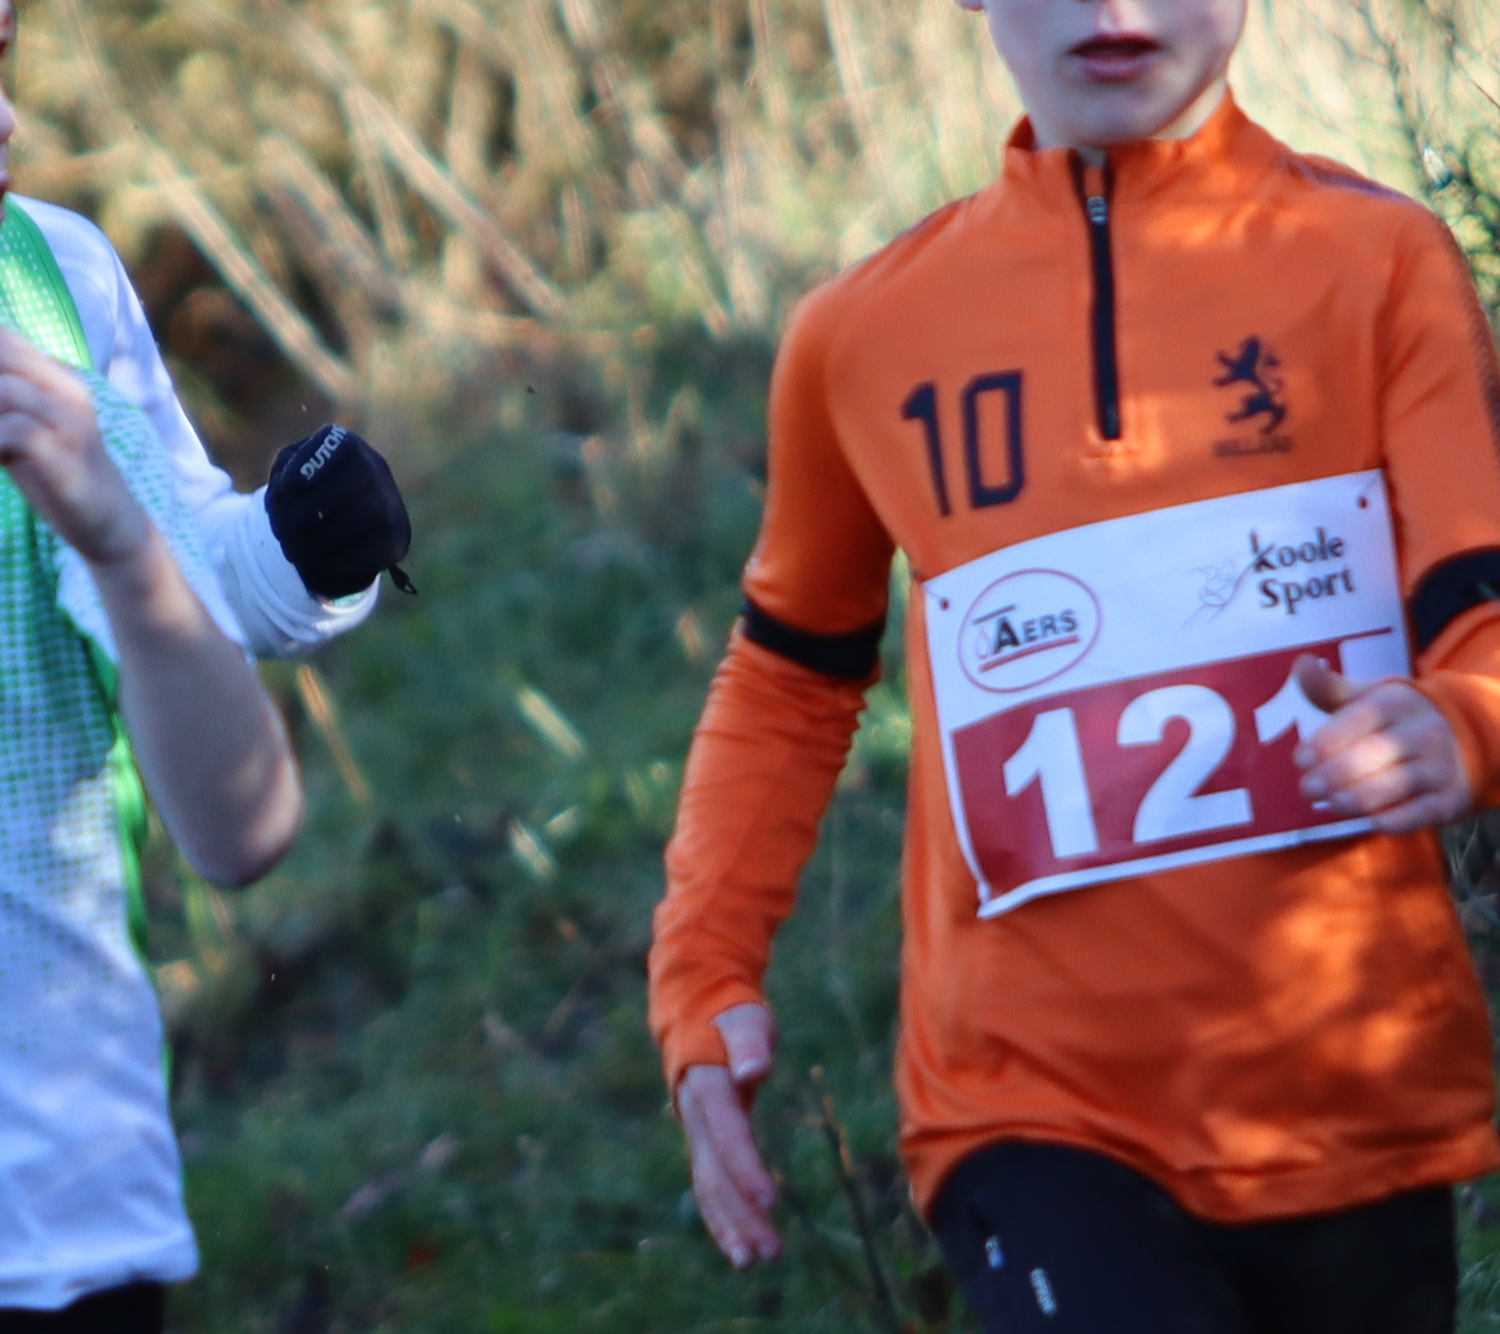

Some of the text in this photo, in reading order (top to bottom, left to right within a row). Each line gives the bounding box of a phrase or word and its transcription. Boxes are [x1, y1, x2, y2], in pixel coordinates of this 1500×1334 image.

[902, 369, 1024, 517] 10
[1259, 568, 1356, 615] Sport
[992, 609, 1079, 656] AERS
